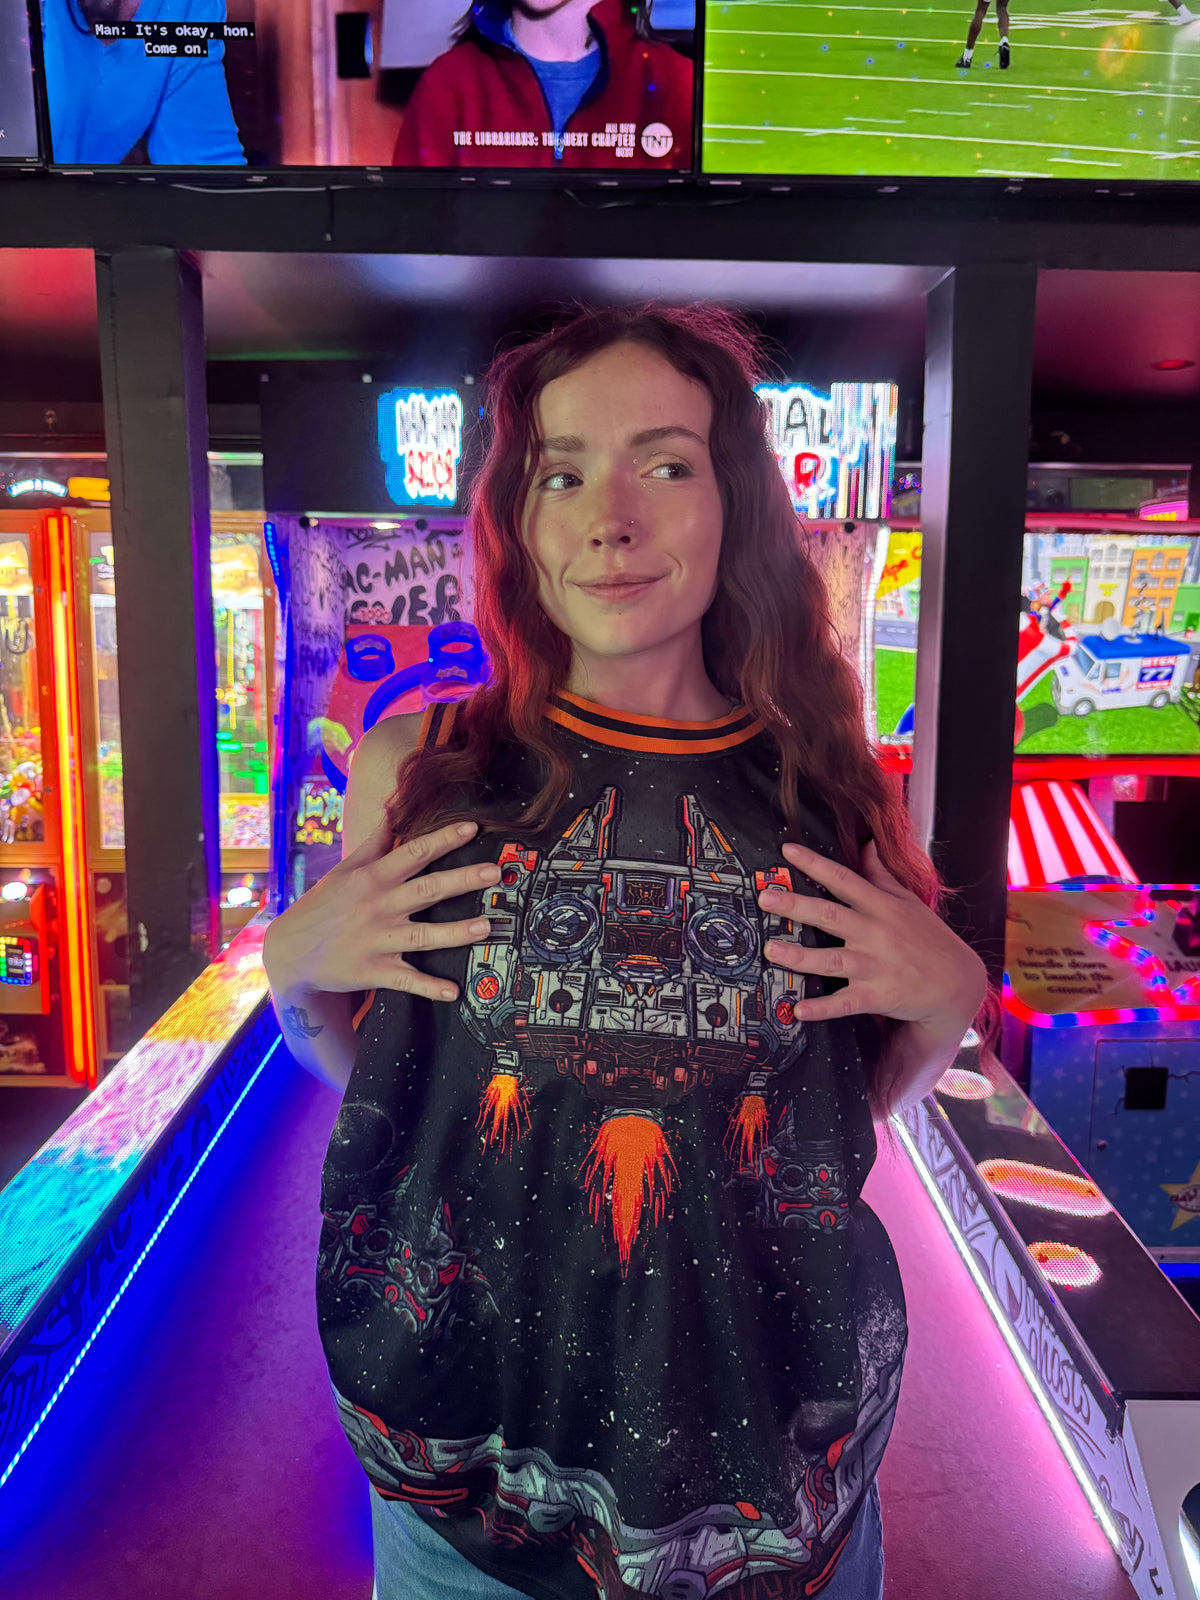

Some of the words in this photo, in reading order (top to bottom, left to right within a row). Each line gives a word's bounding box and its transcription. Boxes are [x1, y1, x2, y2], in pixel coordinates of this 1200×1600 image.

[95, 24, 126, 36] Man:
[136, 24, 168, 36] It's
[175, 25, 214, 39] okay,
[223, 25, 255, 37] hon.
[144, 42, 178, 54] Come
[184, 44, 208, 54] on.
[453, 131, 472, 146] THE
[475, 131, 539, 147] LIBRARIANS:
[563, 132, 589, 147] NEXT
[591, 132, 636, 147] CHAPTER
[1141, 667, 1174, 681] 77
[1023, 971, 1040, 981] to
